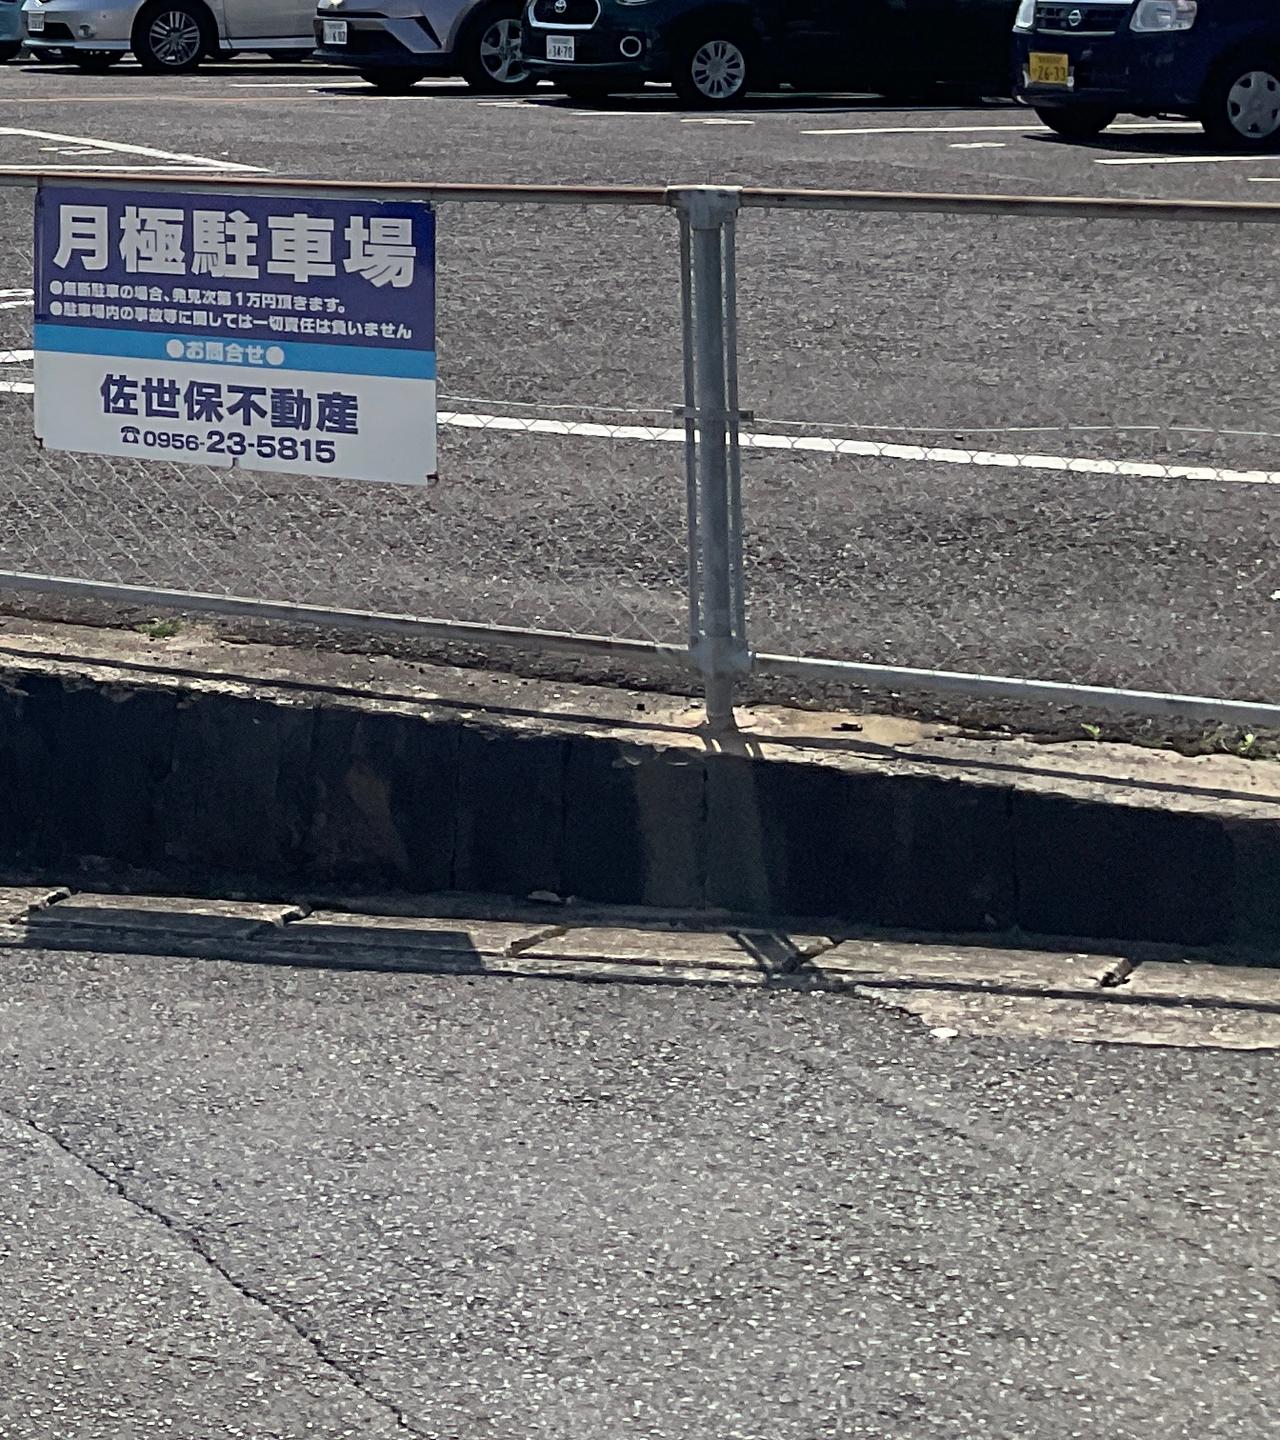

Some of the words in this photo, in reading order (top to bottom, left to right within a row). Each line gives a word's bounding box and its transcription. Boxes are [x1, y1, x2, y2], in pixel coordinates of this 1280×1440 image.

[52, 203, 417, 288] 月極駐車場
[100, 373, 360, 435] 佐世保不動産
[143, 429, 337, 464] 0956-23-5815
